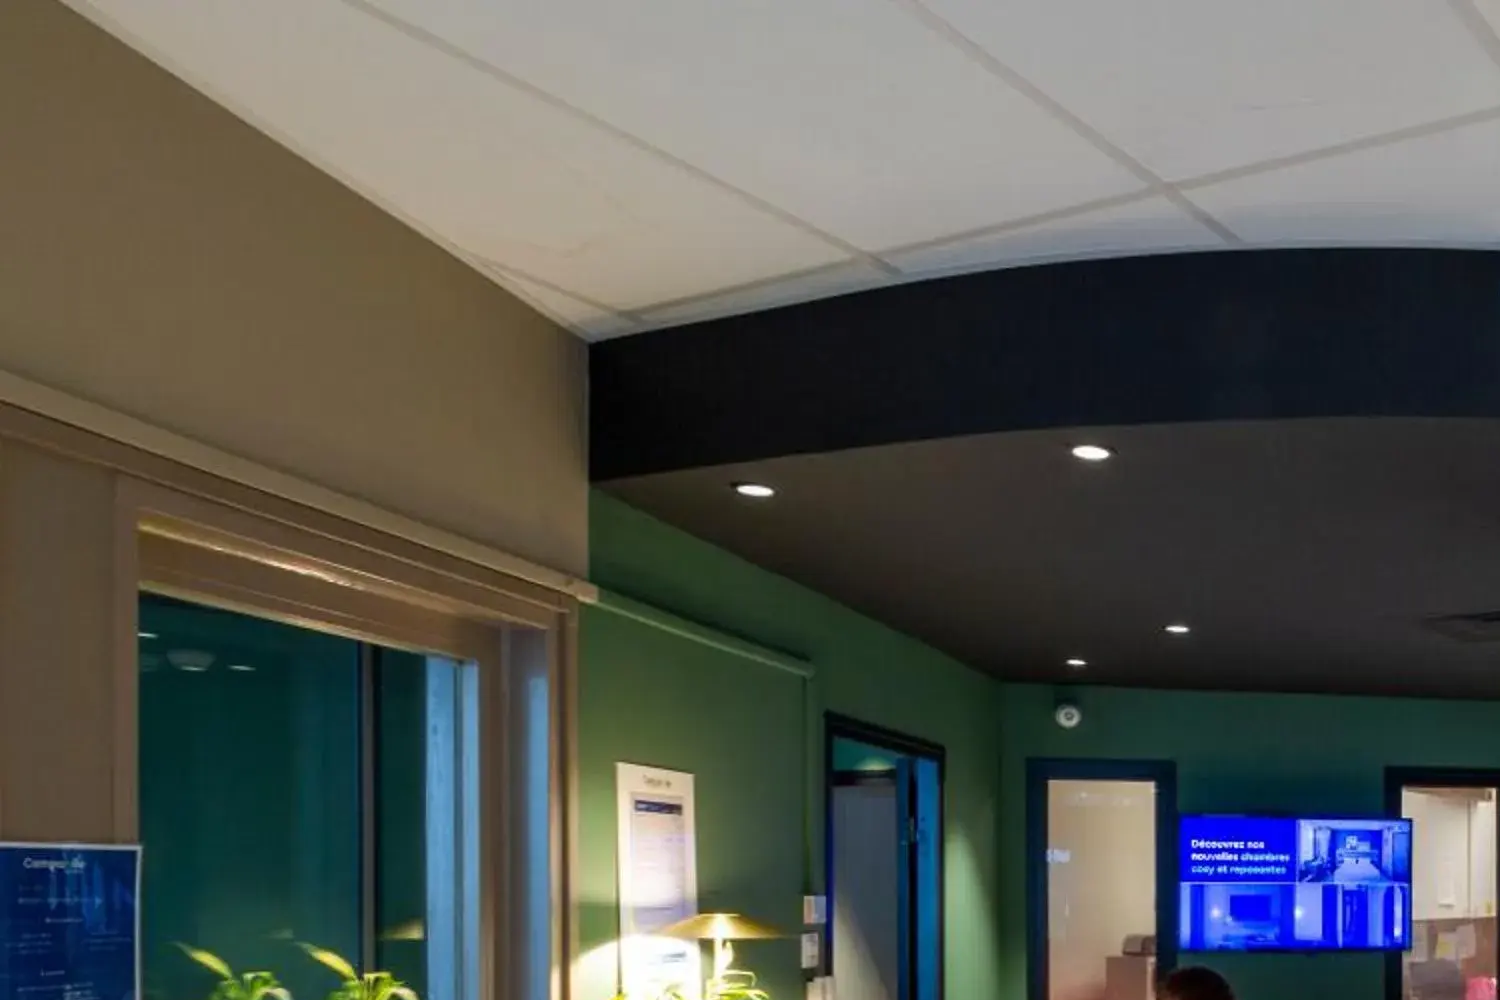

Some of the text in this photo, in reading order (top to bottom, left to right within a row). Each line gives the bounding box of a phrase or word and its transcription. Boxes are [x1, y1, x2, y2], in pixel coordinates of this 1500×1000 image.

[1191, 838, 1265, 849] Découvrez nos
[1191, 852, 1290, 862] nouvelles chambres
[1217, 865, 1228, 874] et
[1229, 865, 1287, 875] reposantes
